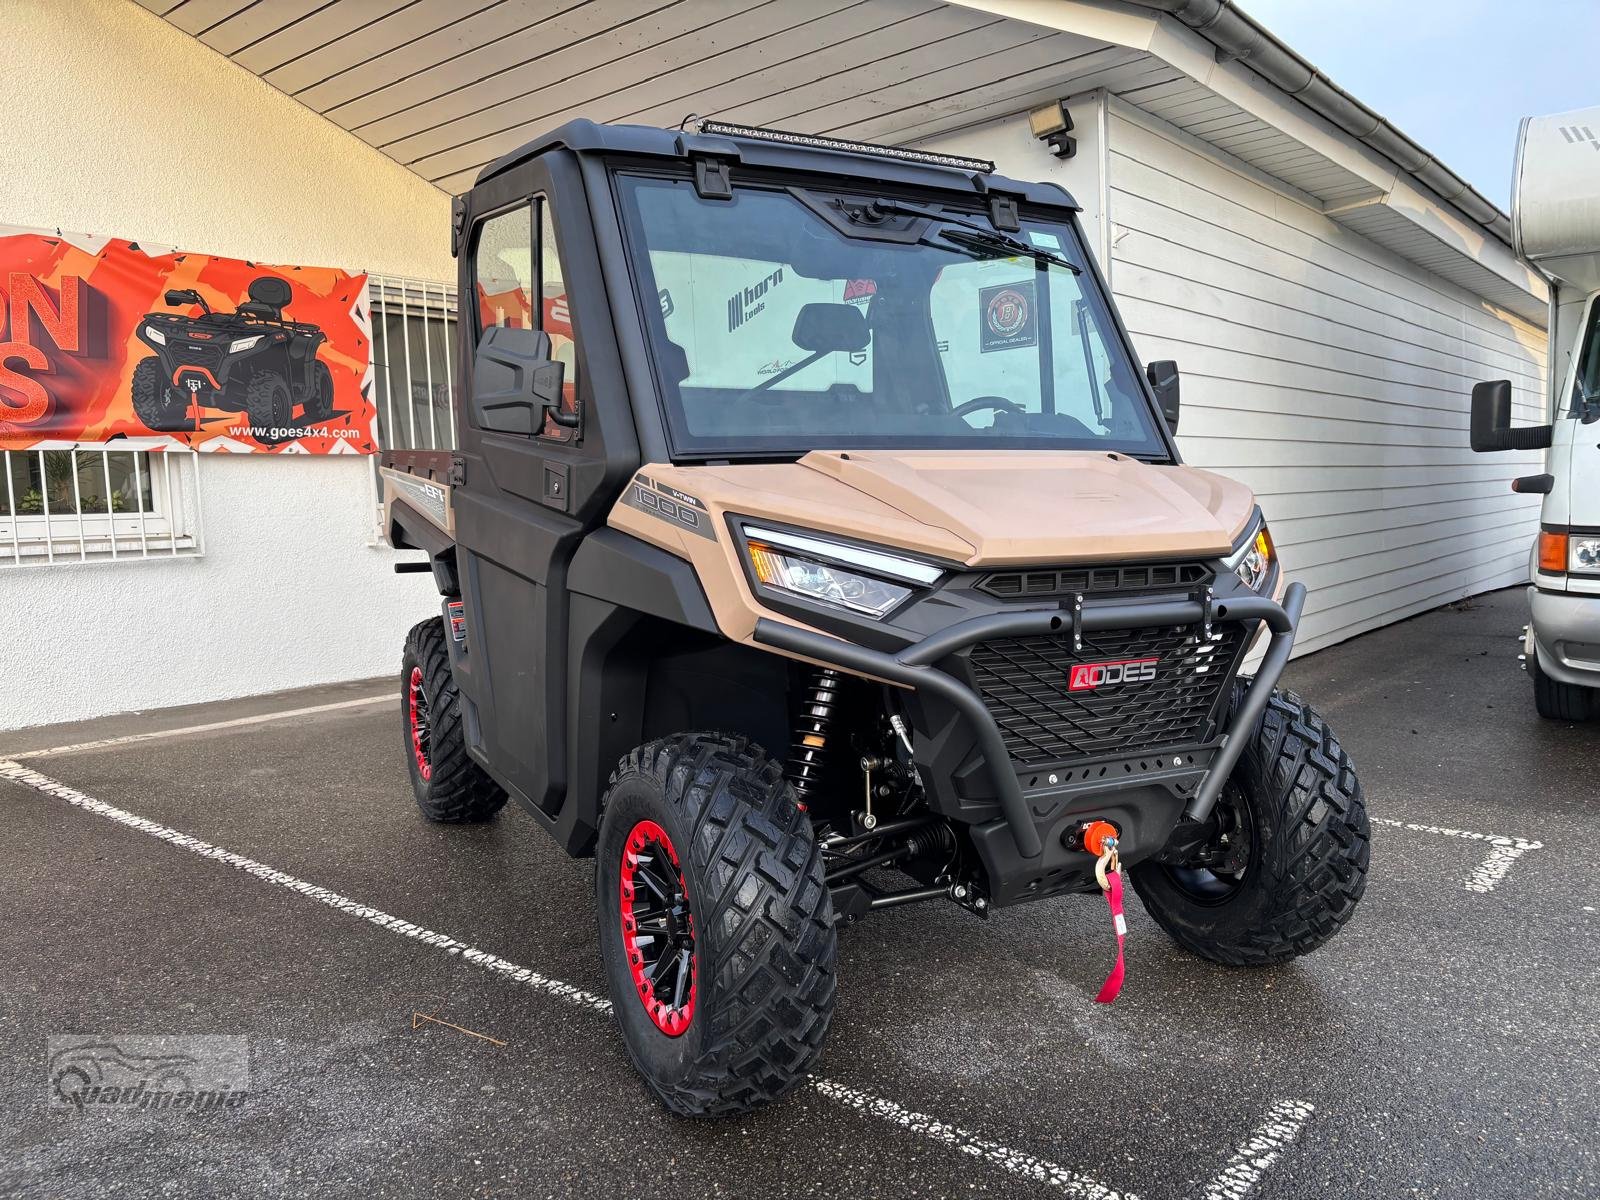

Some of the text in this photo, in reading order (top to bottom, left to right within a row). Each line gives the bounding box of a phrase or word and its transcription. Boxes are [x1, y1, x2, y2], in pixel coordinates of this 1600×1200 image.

[744, 267, 783, 307] horn
[0, 271, 79, 352] N
[744, 302, 765, 322] tools
[229, 426, 360, 439] www.goes4x4.com
[634, 484, 700, 529] 1000
[672, 490, 696, 505] V-TWIN
[1072, 660, 1158, 688] AODES
